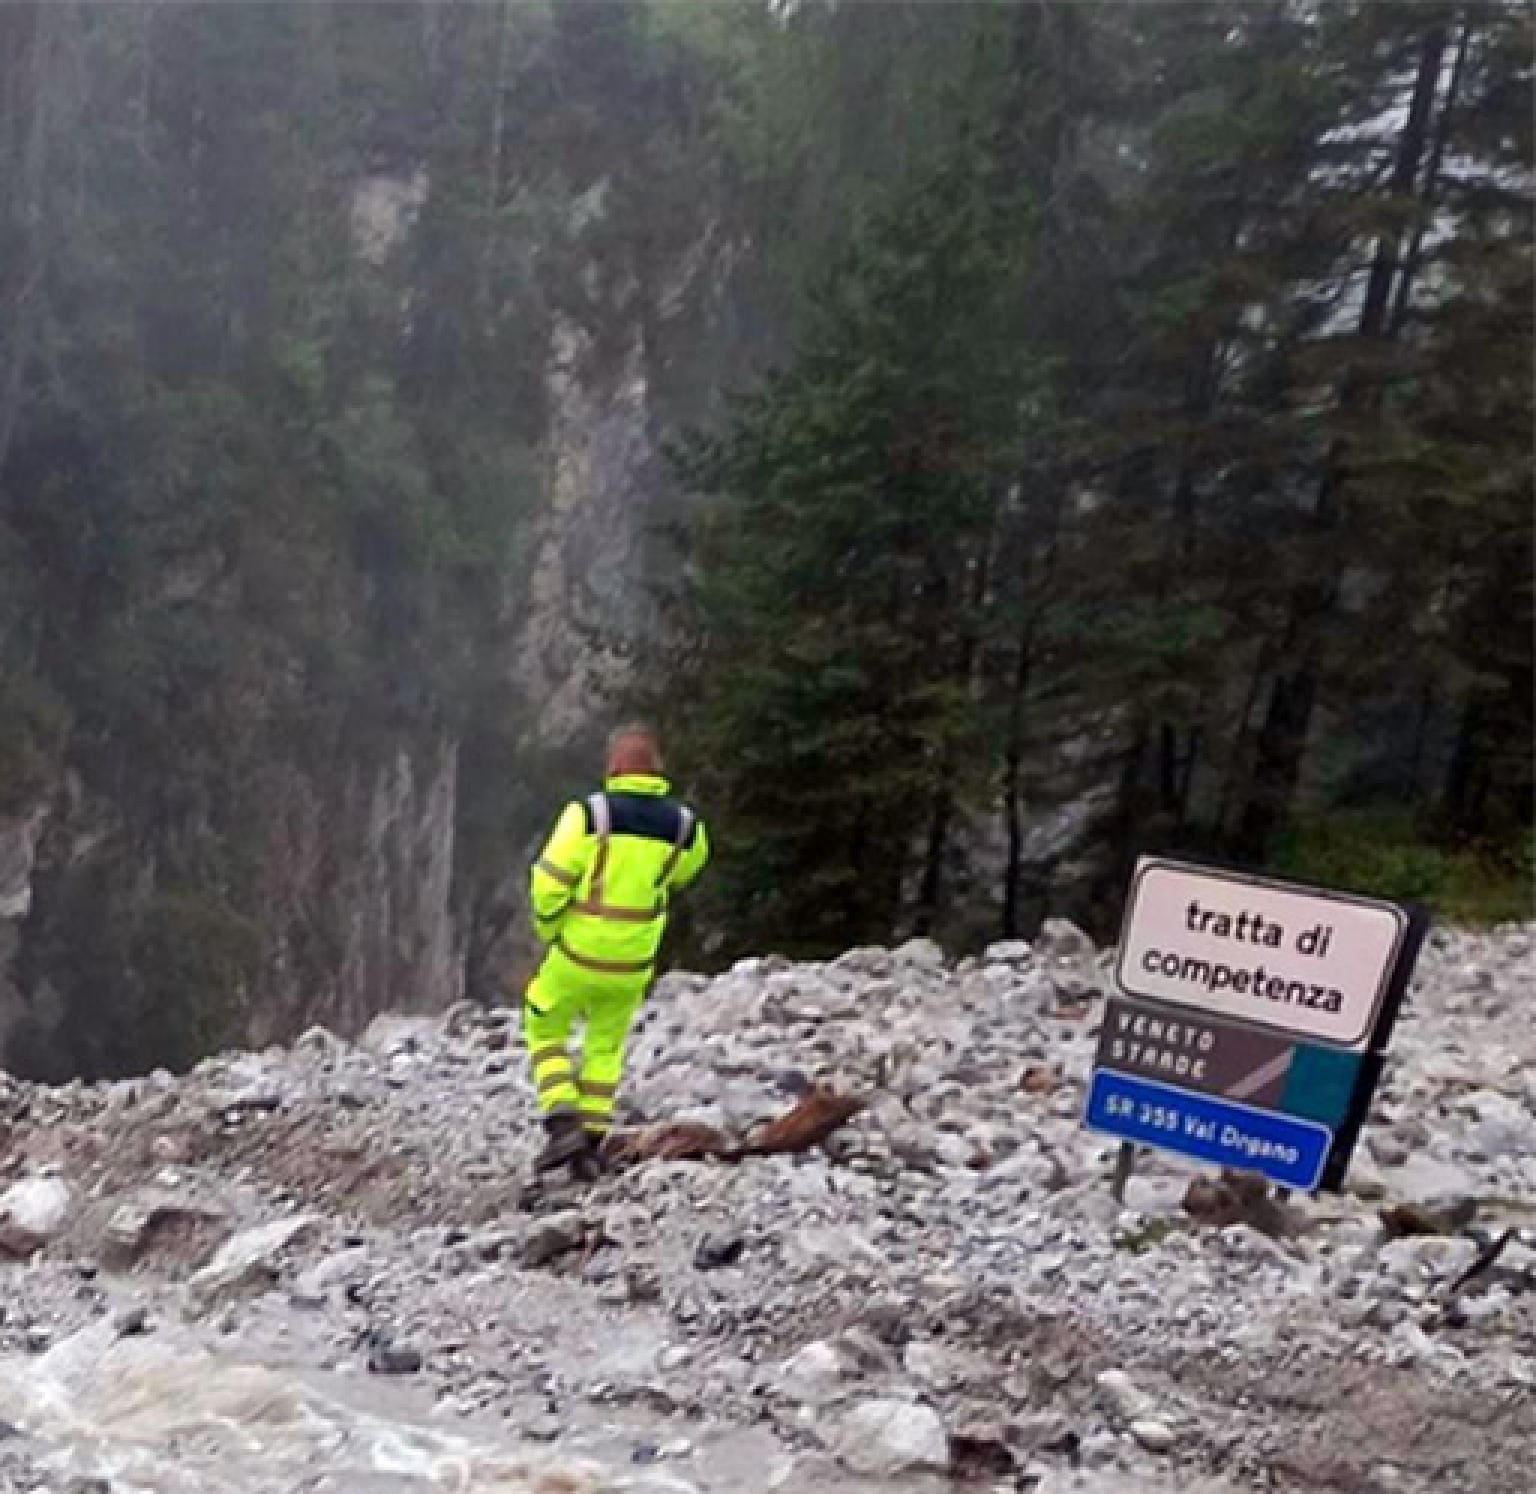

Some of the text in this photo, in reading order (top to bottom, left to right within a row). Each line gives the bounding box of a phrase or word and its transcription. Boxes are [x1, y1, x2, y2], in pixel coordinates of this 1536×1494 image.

[1187, 901, 1333, 957] tratta di
[1143, 948, 1344, 1014] competenza
[1184, 1114, 1218, 1141] Val
